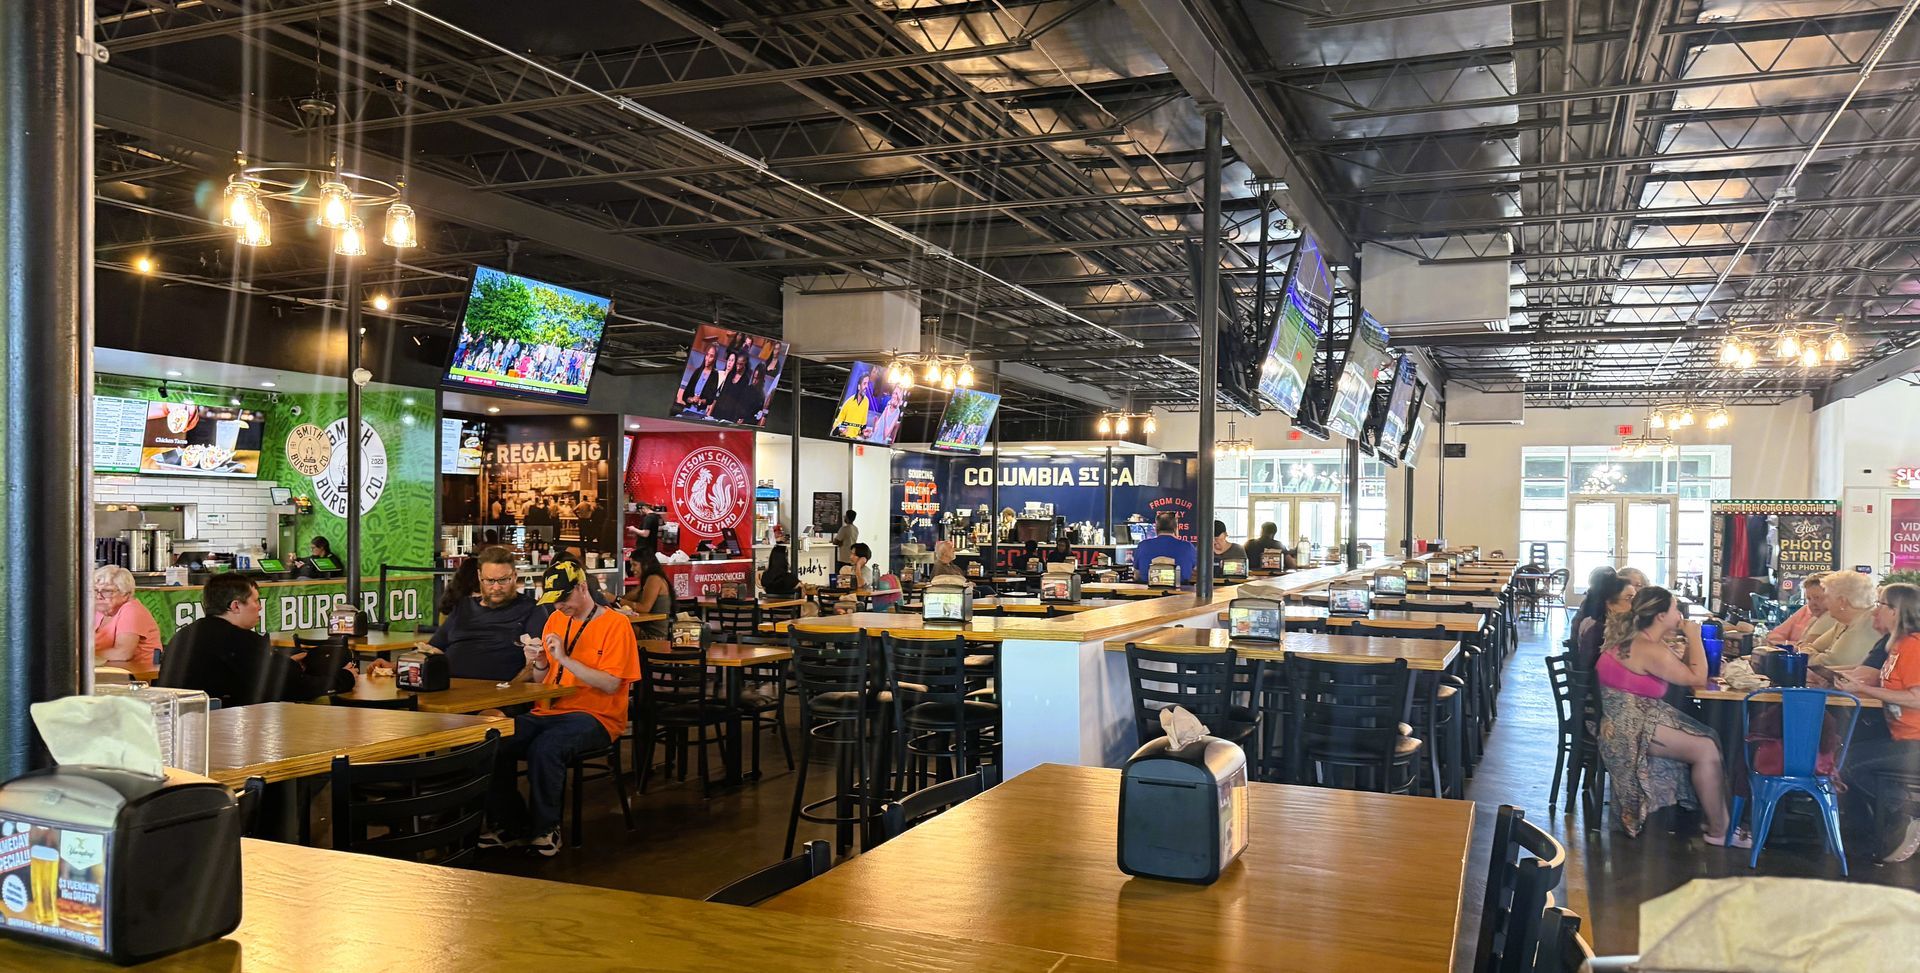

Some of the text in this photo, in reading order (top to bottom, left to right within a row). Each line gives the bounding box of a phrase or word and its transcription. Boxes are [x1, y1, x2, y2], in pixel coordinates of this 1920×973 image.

[296, 426, 323, 441] SMITH
[325, 421, 373, 446] SMH
[497, 437, 601, 463] REGAL PIG
[290, 453, 320, 474] BURGER
[677, 452, 745, 488] WATSON'S CHICKEN
[964, 467, 1075, 486] COLUMBIA
[1104, 467, 1139, 486] CA
[316, 476, 384, 515] BURG CO.
[1149, 497, 1193, 510] FROM OUR
[1745, 503, 1824, 512] PHOTOBOOTH
[684, 513, 737, 532] AT THE YARD
[1780, 539, 1832, 551] PHOTO
[1780, 551, 1833, 562] STRIPS
[280, 591, 378, 631] BURR
[389, 588, 423, 621] CO.
